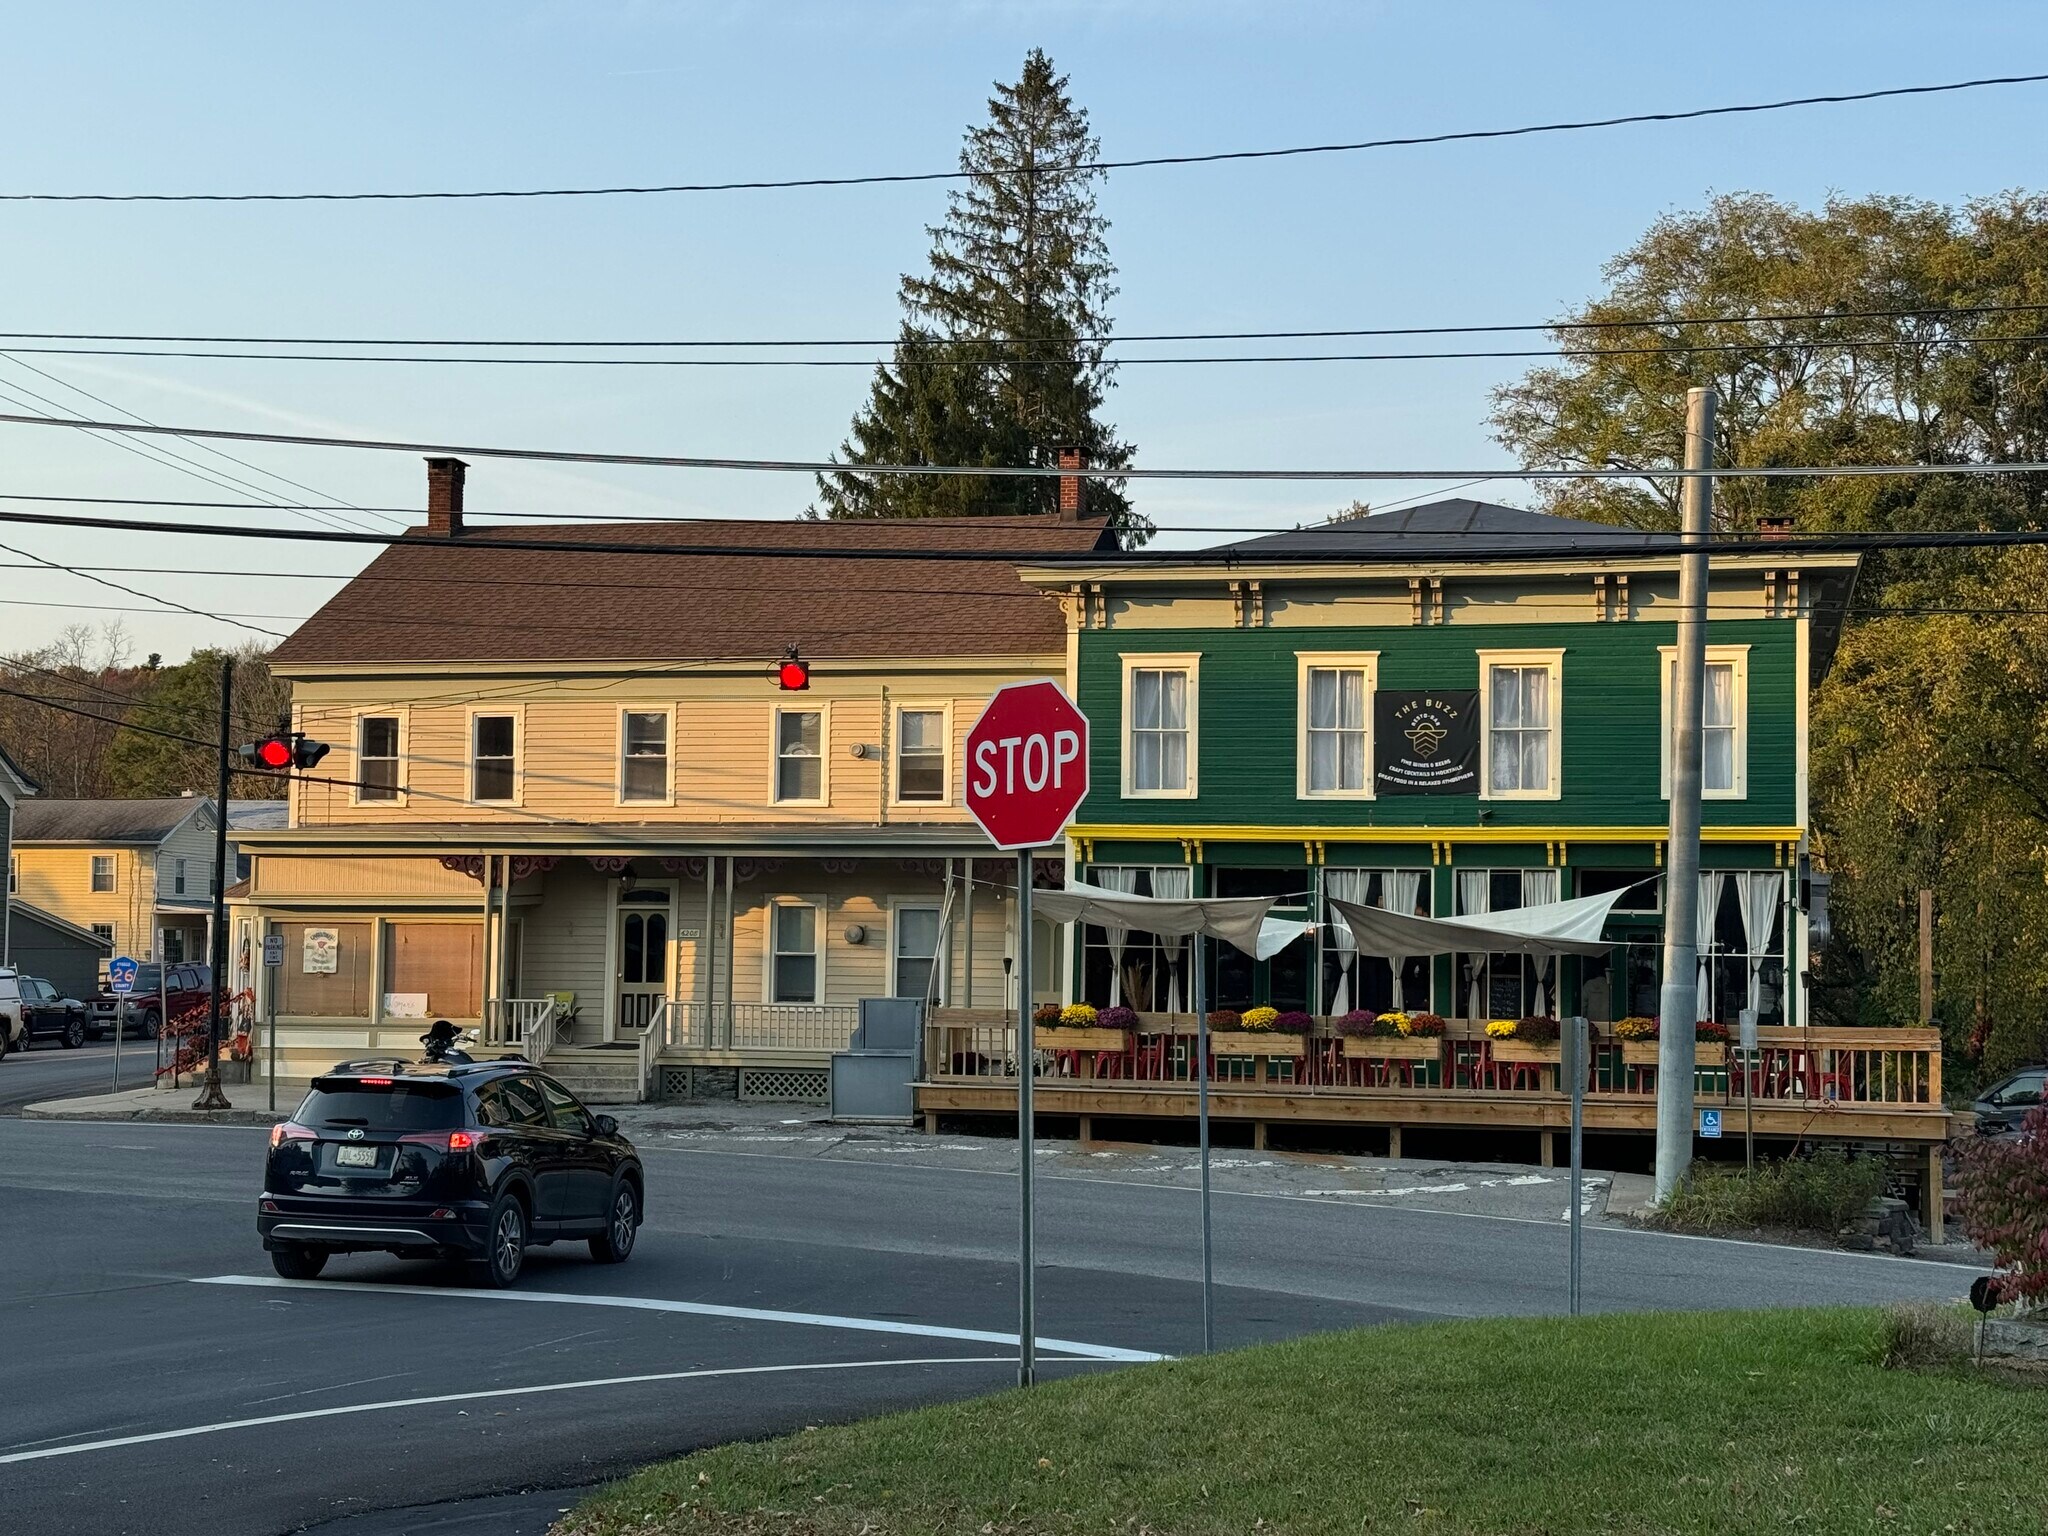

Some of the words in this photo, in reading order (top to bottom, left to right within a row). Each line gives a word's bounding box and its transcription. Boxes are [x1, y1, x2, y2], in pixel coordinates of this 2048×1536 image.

[1394, 701, 1418, 719] THE
[1425, 699, 1458, 719] BUZZ
[973, 730, 1080, 798] STOP
[1389, 765, 1404, 774] CRAFT
[1404, 769, 1430, 777] COCKTAILS
[1435, 764, 1463, 776] MOCKTAILS
[1377, 772, 1394, 782] GREAT
[1394, 777, 1408, 785] FOOD
[1441, 771, 1474, 784] ATMOSPHERE
[113, 967, 134, 982] 26
